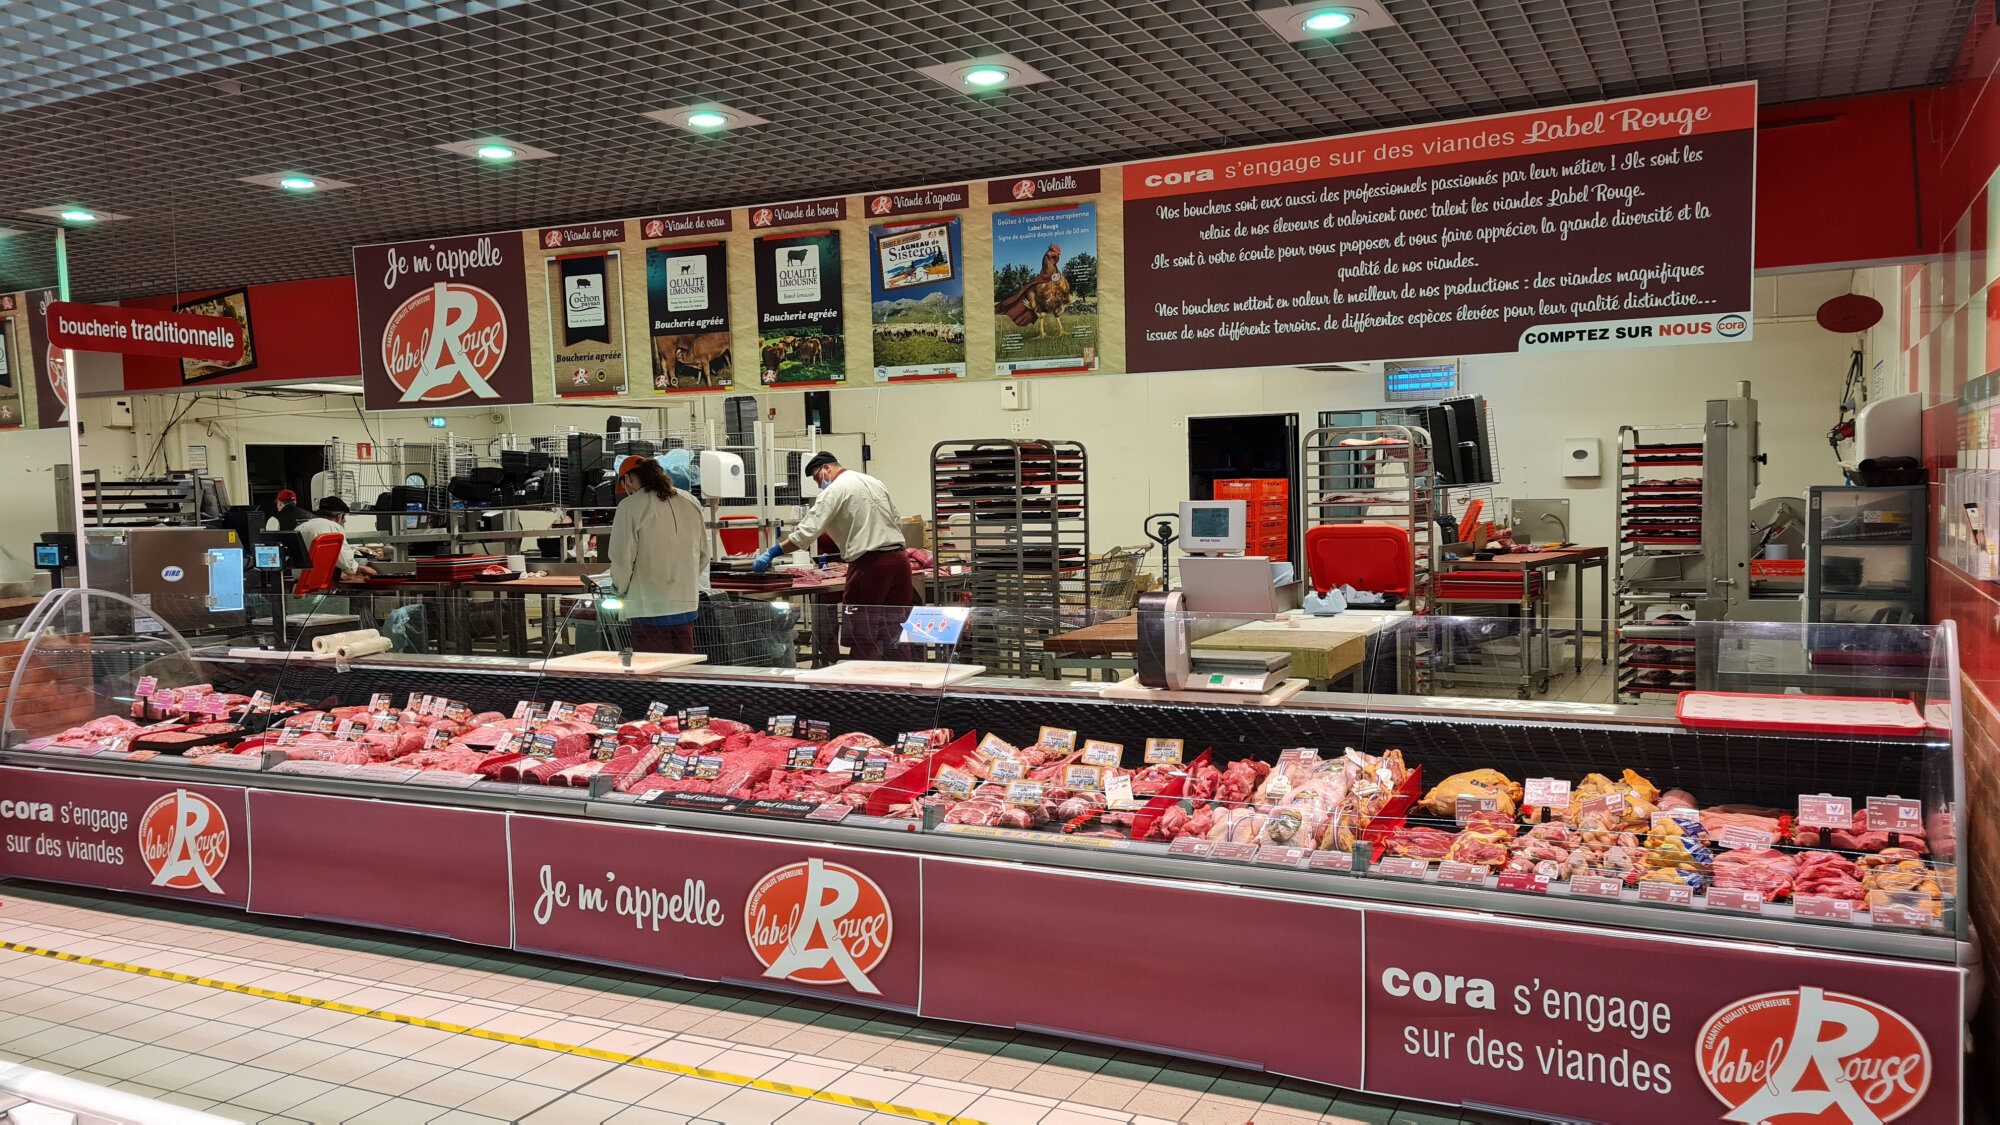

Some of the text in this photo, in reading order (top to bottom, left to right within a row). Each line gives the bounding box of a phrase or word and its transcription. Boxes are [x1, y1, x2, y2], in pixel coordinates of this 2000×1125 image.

[1145, 107, 1711, 187] cora s'engage sur des viandes Label Rouge
[1037, 175, 1077, 192] Volaille
[1156, 146, 1702, 219] Nos bouchers sont eux aussi des professionnels passionnés par leur métier Ils sont les
[774, 208, 803, 221] Viande
[805, 207, 815, 218] de
[893, 191, 962, 210] Viande d'agneau
[1200, 184, 1645, 240] relais de nos éleveurs et valorisent avec talent les viandes Label Rouge.
[665, 217, 726, 232] Viande de veau
[997, 217, 1017, 226] Goûtez
[1022, 215, 1055, 224] l'excellence
[1056, 211, 1090, 221] européenne
[563, 228, 619, 242] Viande de porc
[900, 240, 929, 251] AGNEAU
[1037, 231, 1053, 239] depuis
[1151, 202, 1711, 269] Ils sont à votre écoute pour vous proposer et vous faire apprécier la grande diversité et la
[384, 237, 503, 290] Je m'appelle
[888, 245, 941, 262] Sisteron
[1338, 252, 1479, 282] qualité de nos viandes.
[669, 275, 705, 289] QUALITÉ
[779, 266, 817, 280] QUALITÉ
[779, 277, 818, 287] LIMOUSINE
[569, 292, 600, 309] Cochon
[669, 286, 705, 296] LIMOUSINE
[1155, 263, 1704, 316] Nos bouchers mettent en valeur le meilleur de nos productions des viandes magnifiques
[654, 317, 724, 330] Boucherie agréée
[763, 308, 838, 323] Boucherie agréée
[1147, 330, 1177, 341] issues
[1181, 325, 1194, 339] de
[1197, 328, 1214, 338] nos
[1219, 321, 1270, 341] différents
[1324, 314, 1339, 330] de
[1342, 312, 1403, 332] différentes
[1408, 309, 1452, 327] espèces
[1457, 305, 1499, 321] élevées
[1504, 306, 1535, 322] pour
[1539, 299, 1567, 315] leur
[1571, 295, 1620, 317] qualité
[1624, 291, 1716, 309] distinctive...
[59, 316, 235, 349] boucherie traditionnelle
[1525, 319, 1745, 344] COMPTEZ SUR NOUS cora
[389, 327, 429, 376] label
[555, 350, 622, 363] Boucherie agréée
[0, 798, 54, 823] cora
[61, 799, 129, 833] s'engage
[6, 832, 125, 866] sur des viandes
[144, 824, 174, 863] label
[533, 864, 725, 932] Je m'appelle
[751, 902, 801, 956] label
[1381, 965, 1672, 1041] cora s'engage
[1704, 997, 1791, 1050] GARANTIE QUALITÉ SUPÉRIEURE
[1403, 1022, 1673, 1096] sur des viandes
[1705, 1036, 1785, 1097] label
